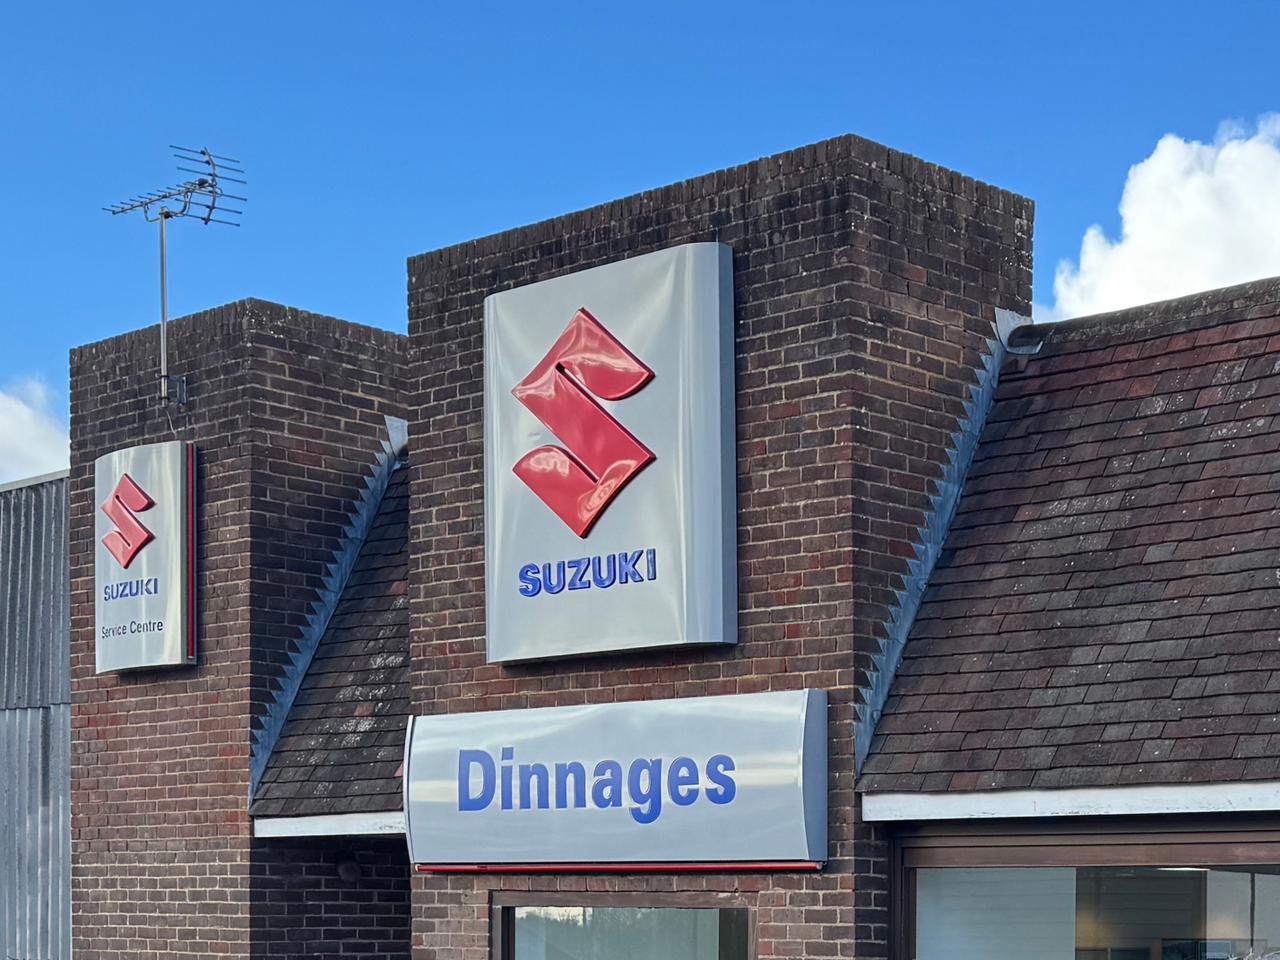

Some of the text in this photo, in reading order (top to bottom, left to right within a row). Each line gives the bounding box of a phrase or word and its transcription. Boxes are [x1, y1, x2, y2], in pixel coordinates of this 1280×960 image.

[104, 578, 159, 601] SUZUKI
[518, 548, 656, 597] SUZUKI
[102, 620, 164, 639] Service Centre
[458, 747, 736, 824] Dinnages
